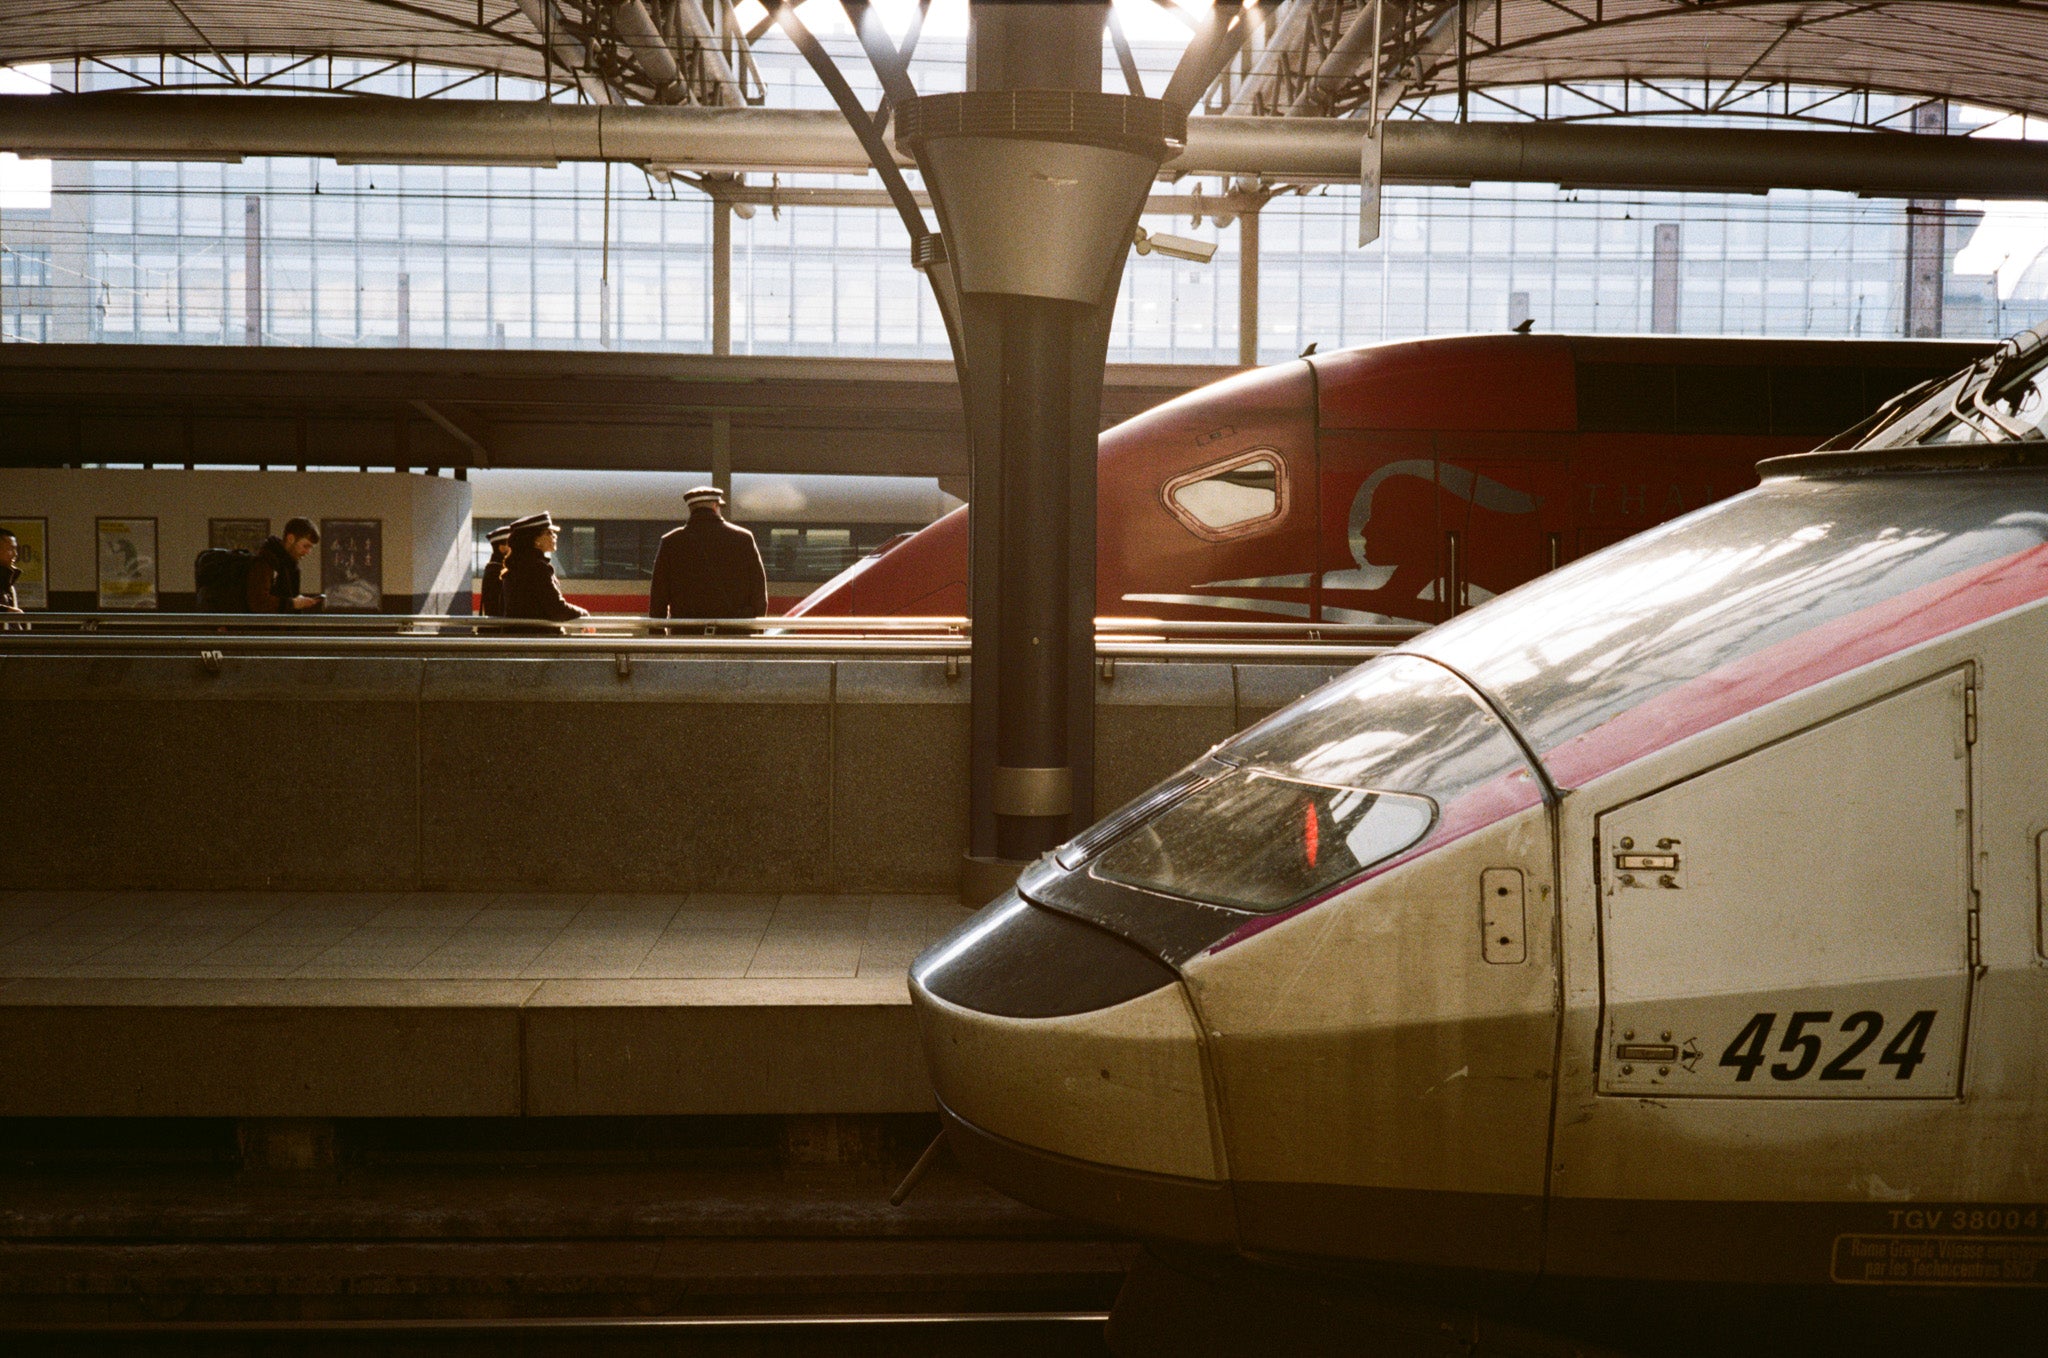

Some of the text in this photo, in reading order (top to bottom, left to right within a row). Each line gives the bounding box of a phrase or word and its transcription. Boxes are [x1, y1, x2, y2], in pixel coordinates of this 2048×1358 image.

[1584, 483, 1744, 514] THA
[1719, 1010, 1938, 1082] 4524
[1888, 1210, 1943, 1230] TGV
[1851, 1238, 1886, 1257] Rame
[1890, 1239, 1935, 1258] Grande
[1938, 1239, 1984, 1259] Vitesse
[1865, 1262, 1887, 1280] par
[1888, 1258, 1908, 1276] les
